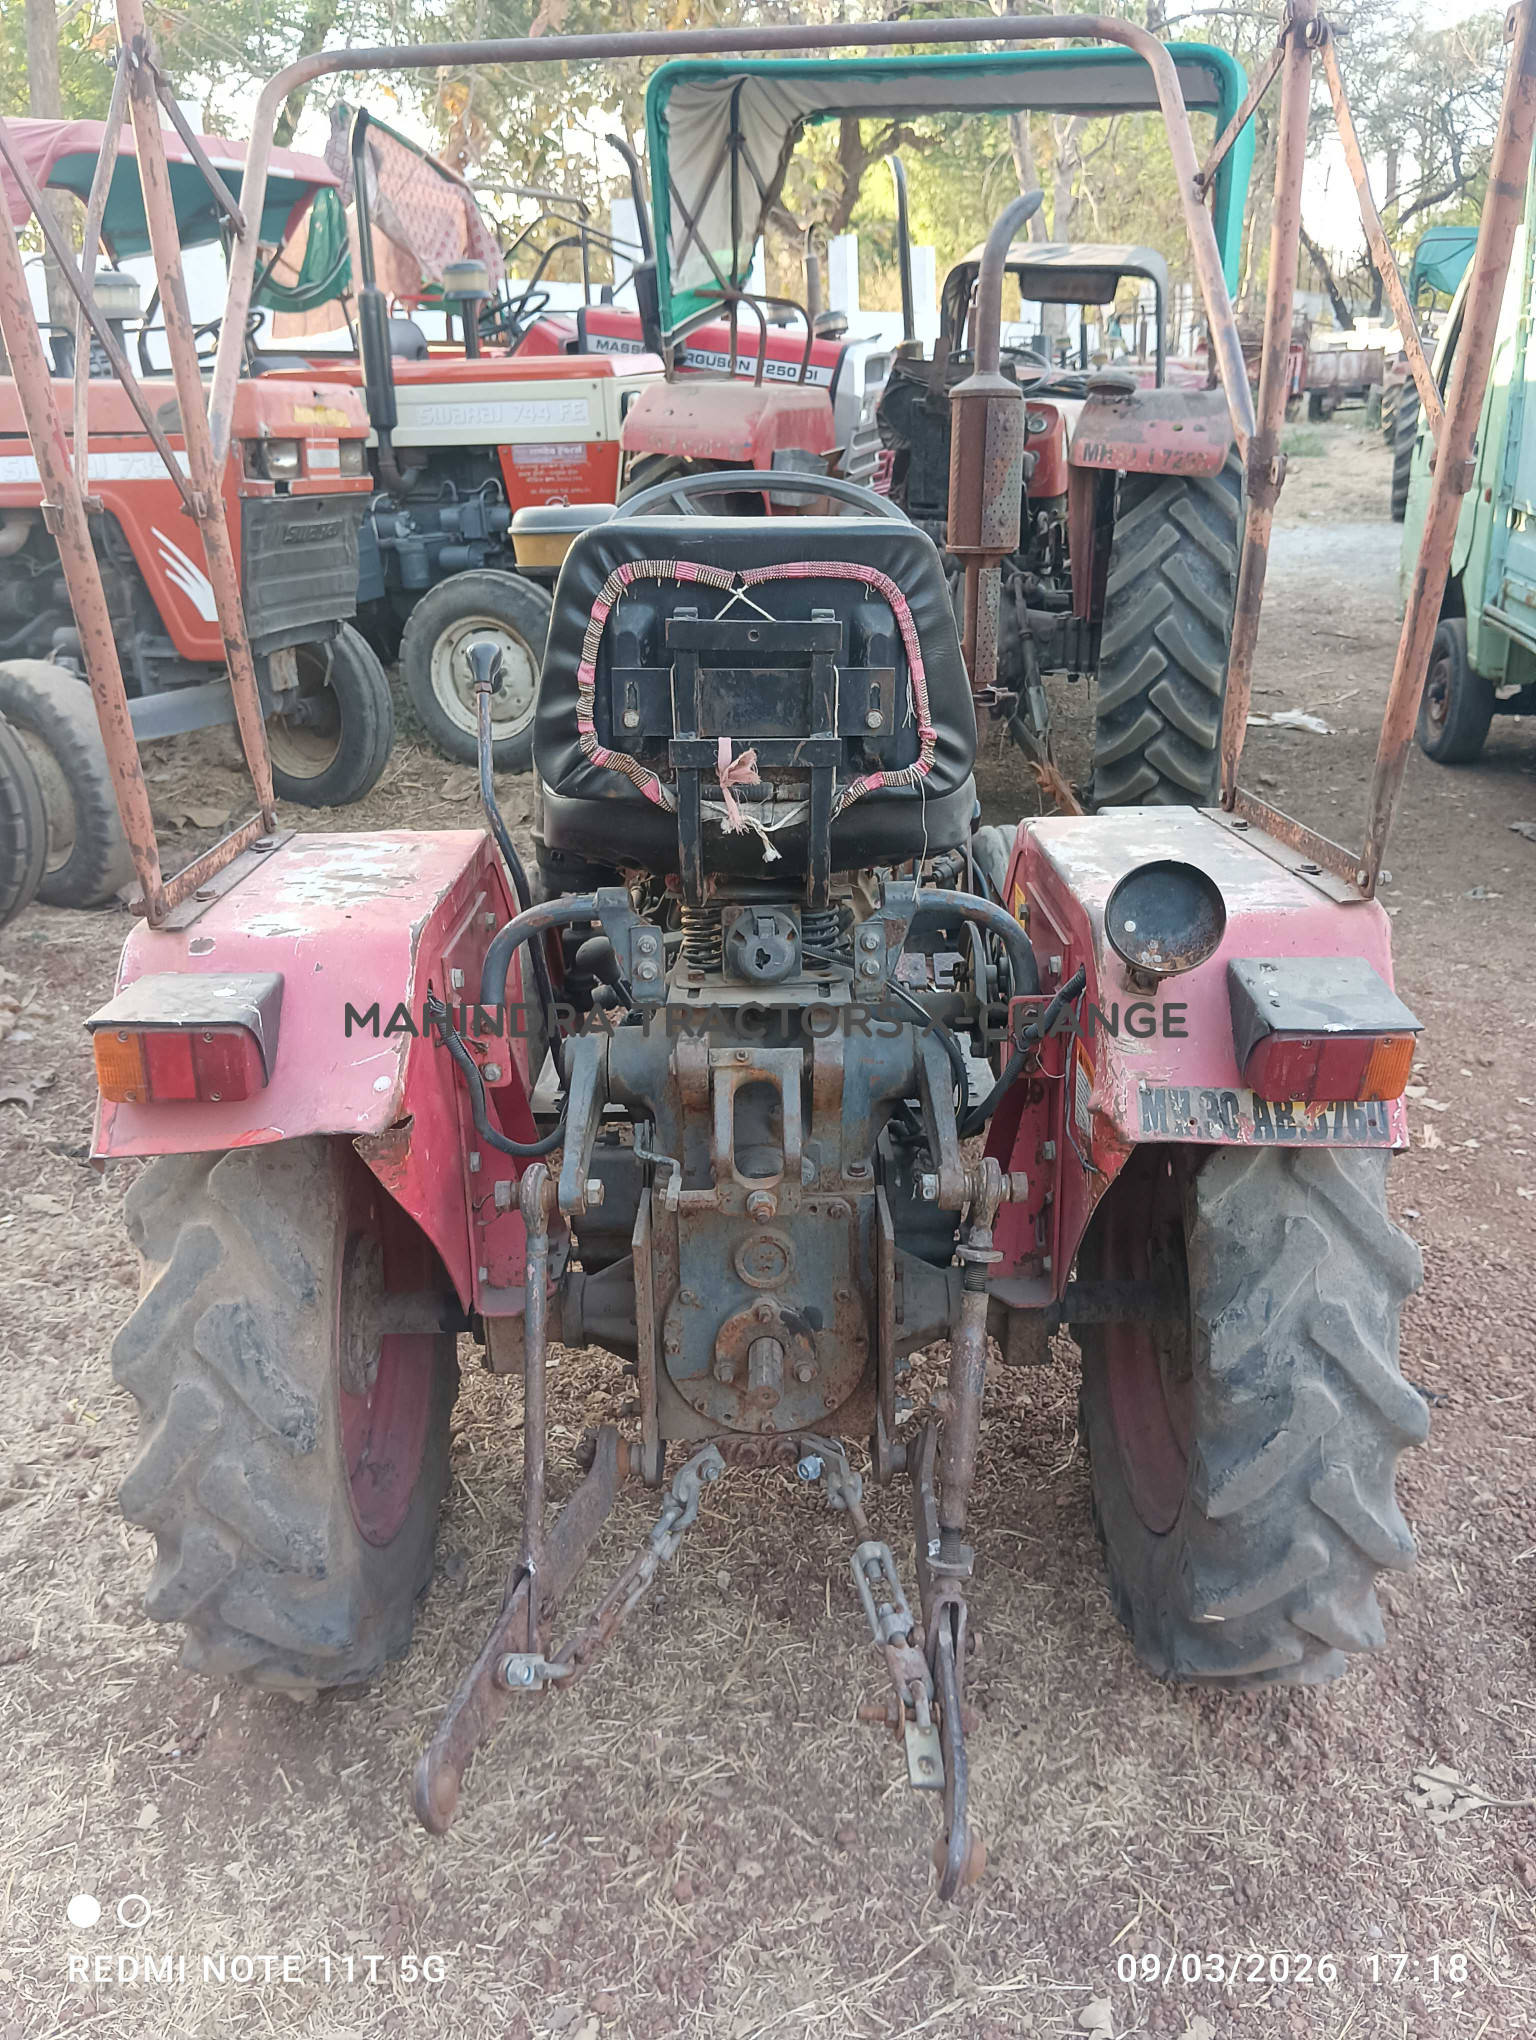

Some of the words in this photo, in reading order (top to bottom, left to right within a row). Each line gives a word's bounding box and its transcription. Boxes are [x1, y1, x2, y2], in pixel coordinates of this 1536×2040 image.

[596, 339, 647, 356] MASS
[687, 354, 751, 372] RGUSN
[763, 360, 797, 378] 250
[513, 403, 549, 423] 744
[560, 401, 586, 421] FE
